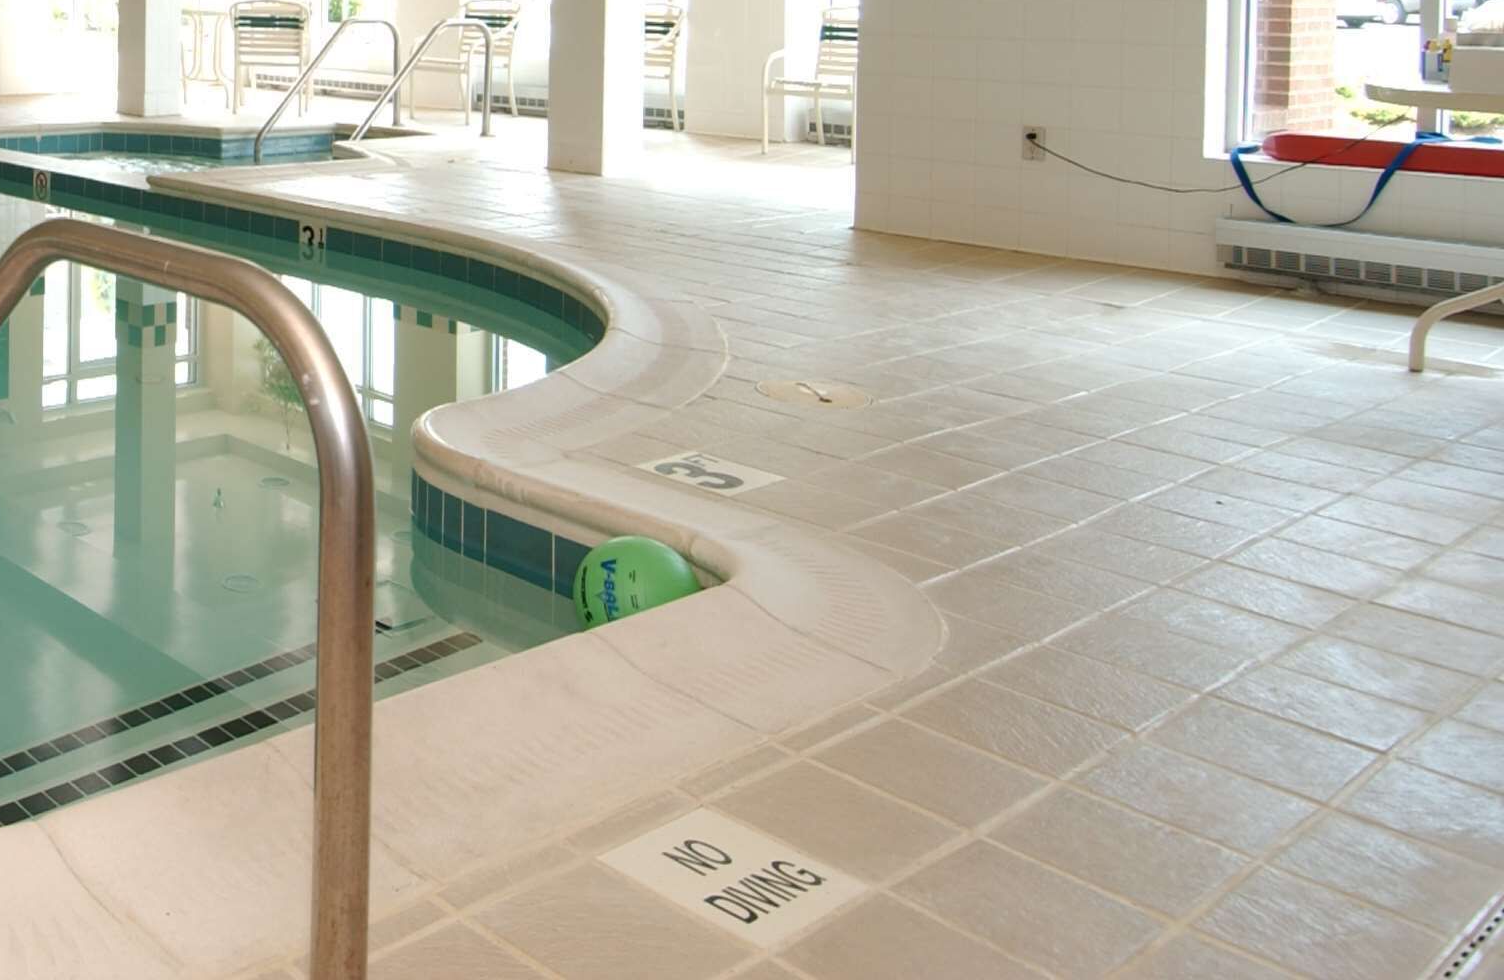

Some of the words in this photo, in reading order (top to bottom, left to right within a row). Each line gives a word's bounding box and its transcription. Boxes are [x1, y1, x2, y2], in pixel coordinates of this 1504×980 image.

[654, 462, 744, 490] 3
[662, 839, 732, 876] NO
[704, 860, 827, 924] DIVING
